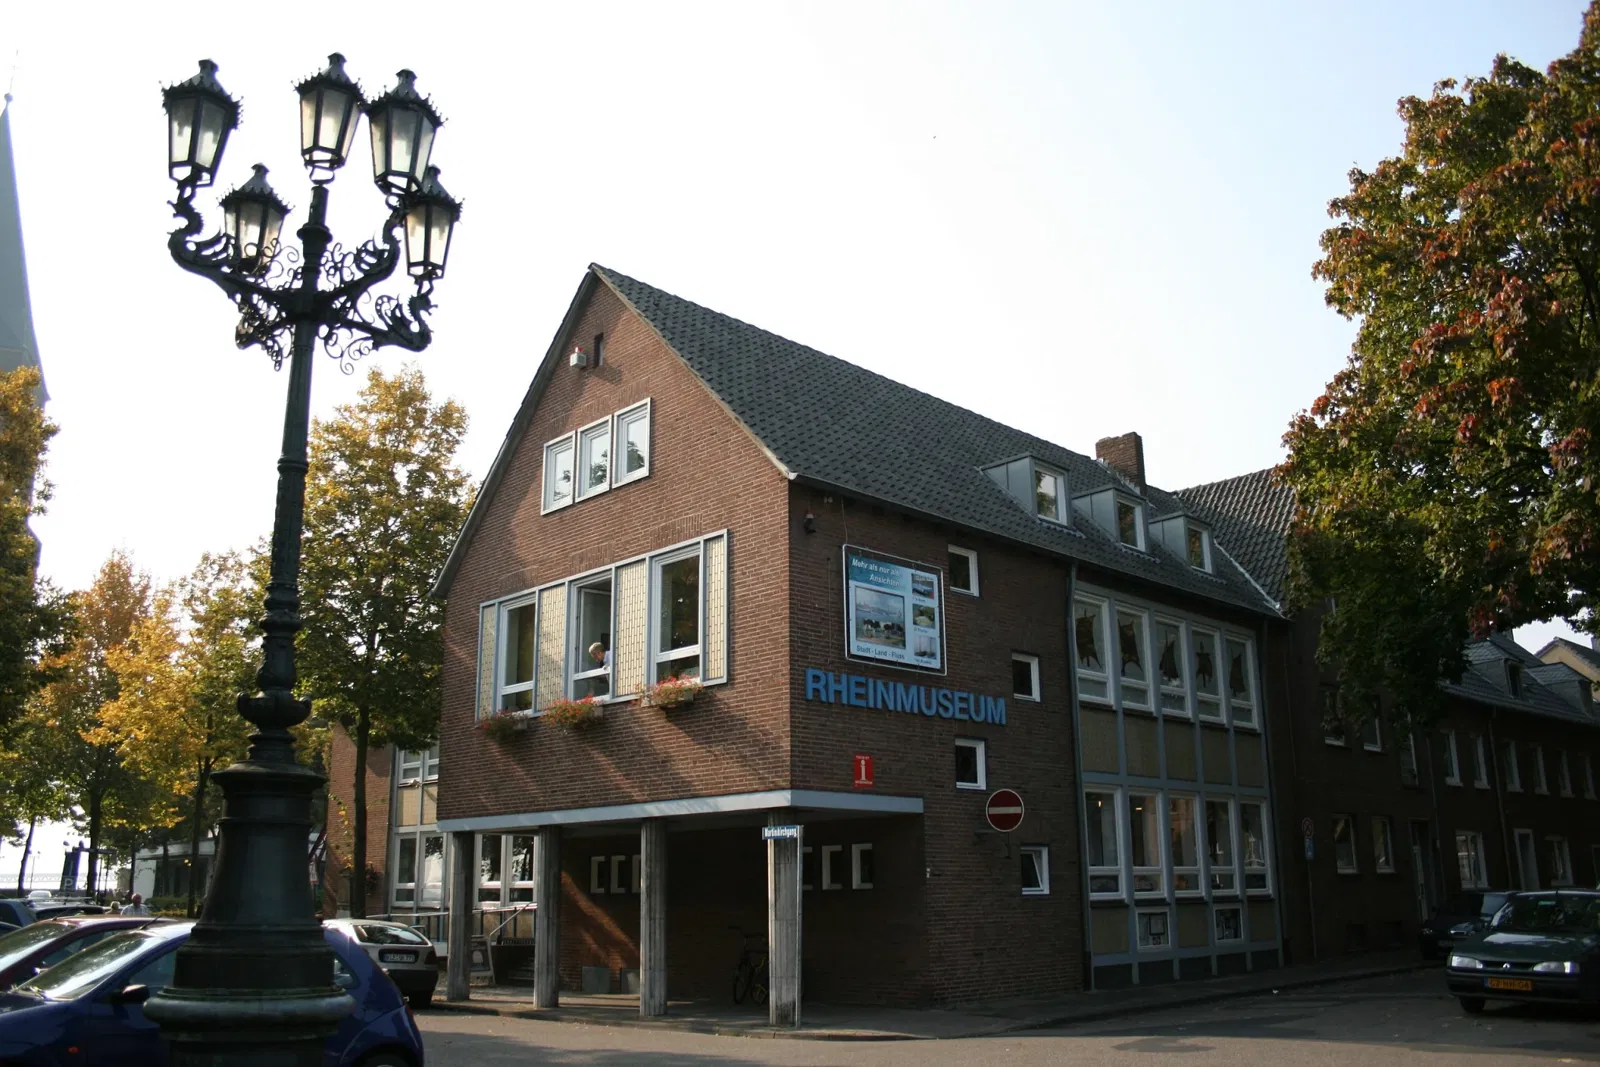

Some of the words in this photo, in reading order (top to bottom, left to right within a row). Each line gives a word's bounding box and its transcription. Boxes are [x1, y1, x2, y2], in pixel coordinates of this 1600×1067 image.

[852, 559, 868, 569] Mehr
[869, 563, 878, 572] als
[880, 566, 890, 574] nur
[869, 573, 901, 587] Ansichten
[856, 645, 871, 654] Stadt
[875, 648, 888, 656] Land
[804, 667, 1007, 725] RHEINMUSEUM
[65, 878, 73, 890] P
